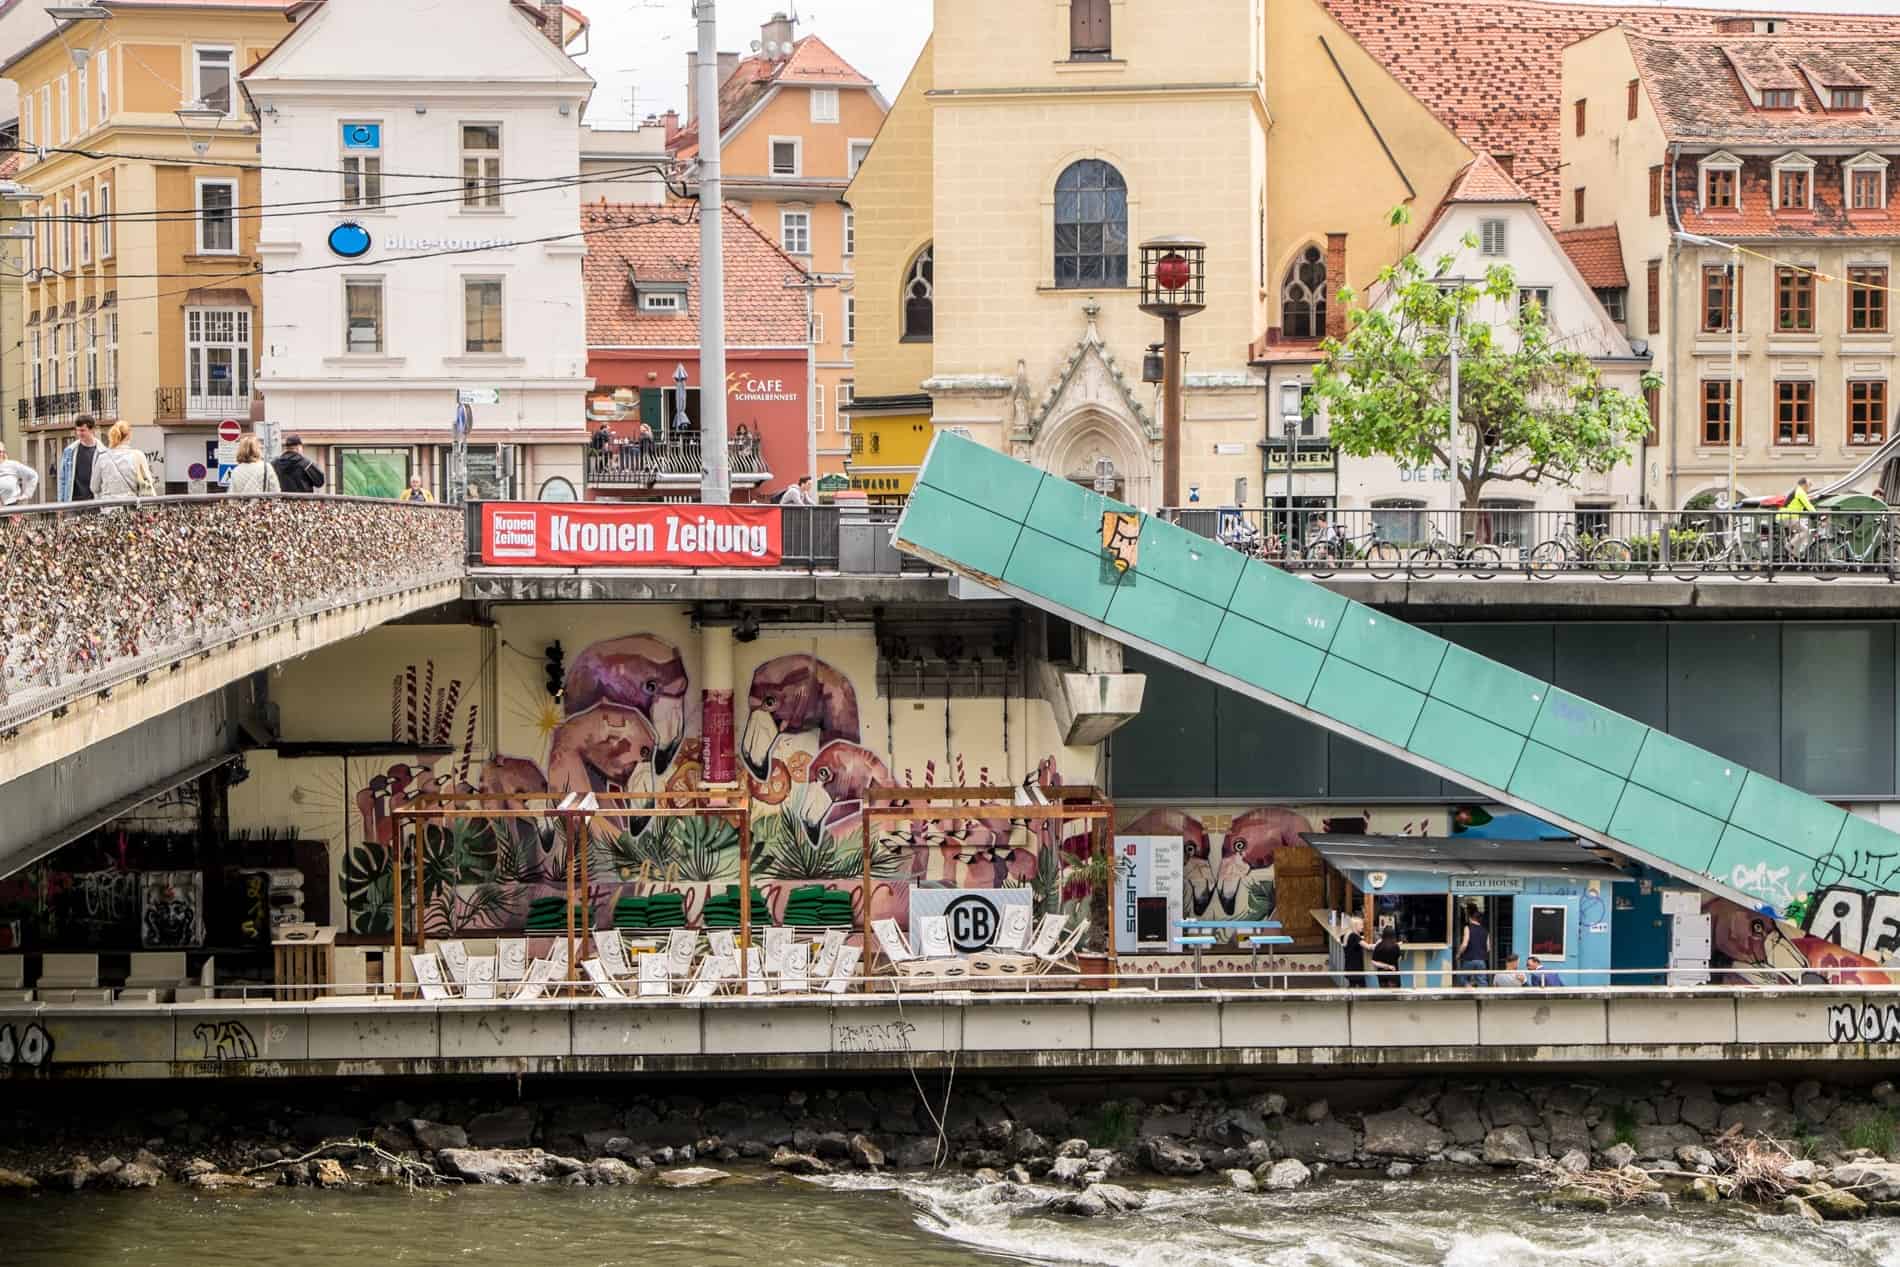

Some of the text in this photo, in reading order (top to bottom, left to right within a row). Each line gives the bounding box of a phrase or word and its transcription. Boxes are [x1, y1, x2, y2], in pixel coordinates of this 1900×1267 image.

[747, 379, 783, 393] CAFE
[495, 516, 534, 530] Kronen
[495, 531, 534, 546] Zeitung
[551, 514, 768, 557] Kronen Zeitung
[1456, 879, 1519, 888] BEACH HOUSE
[953, 906, 990, 941] CB
